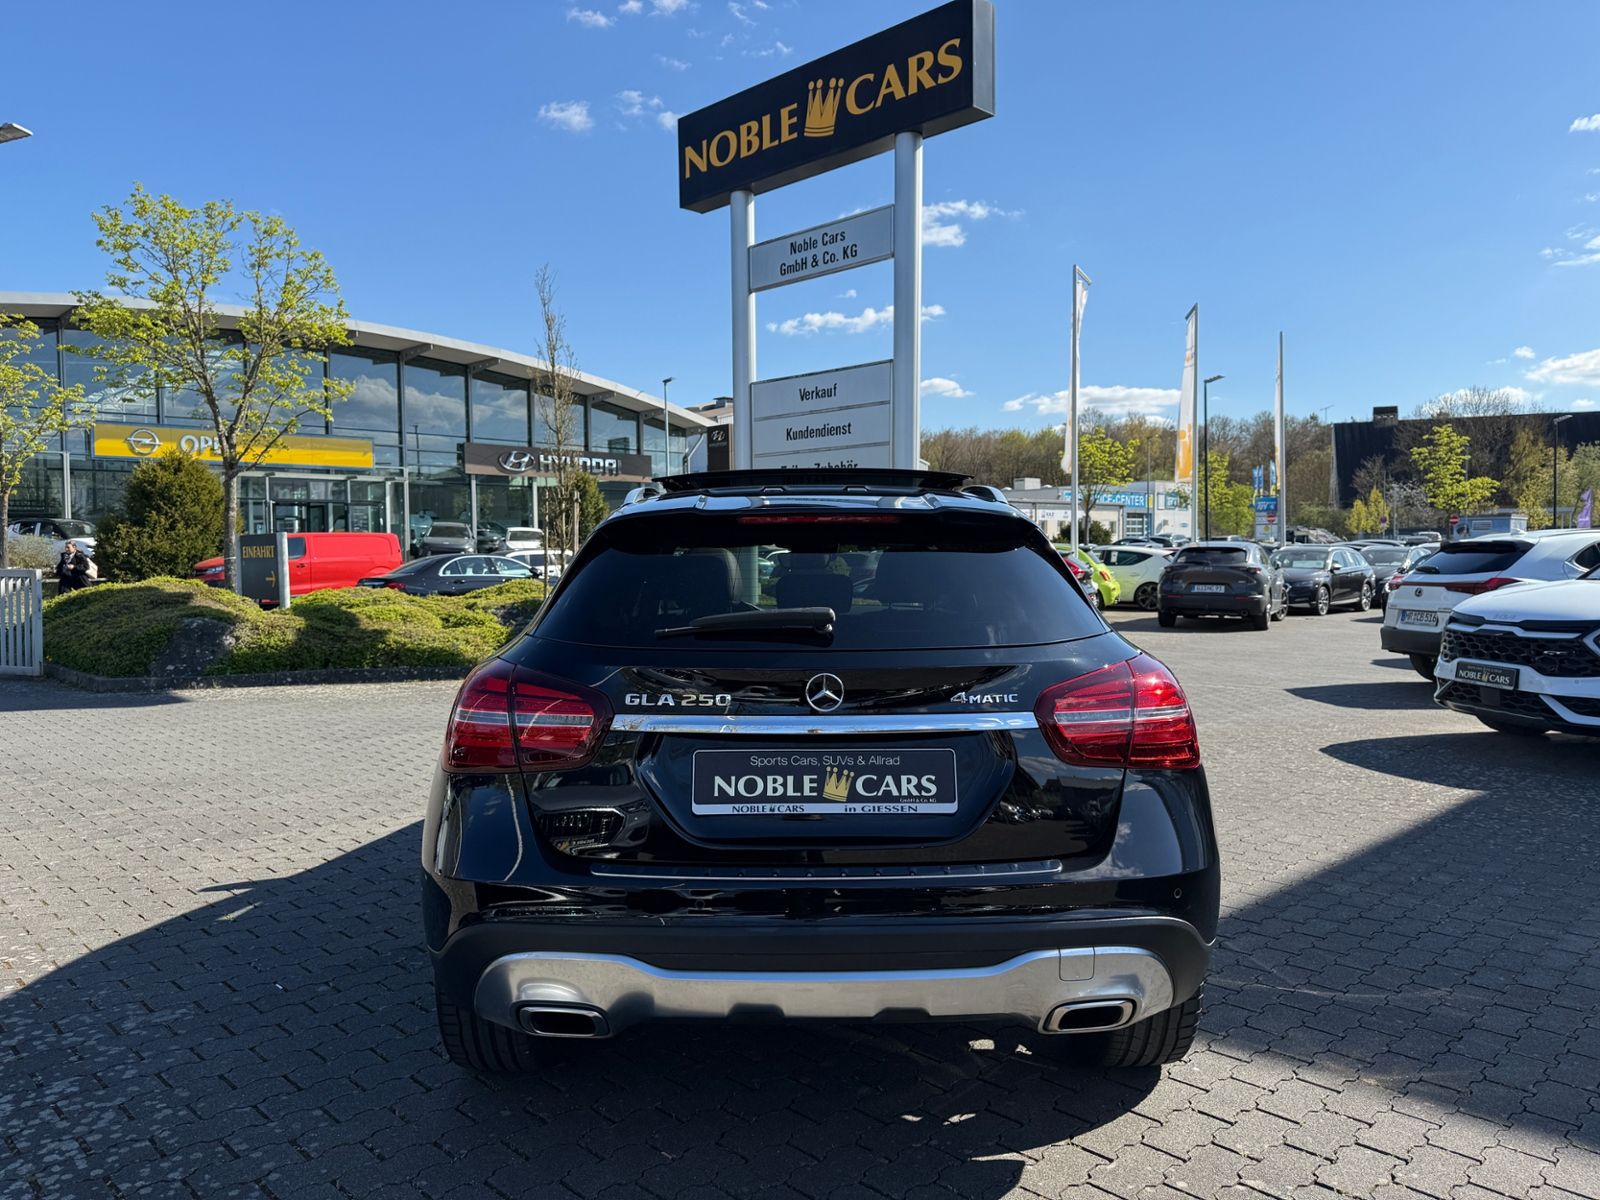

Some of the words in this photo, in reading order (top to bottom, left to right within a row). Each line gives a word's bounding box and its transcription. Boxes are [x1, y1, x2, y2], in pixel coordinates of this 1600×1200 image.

[684, 103, 798, 178] NOBLE
[845, 38, 963, 115] CARS
[790, 236, 818, 255] Noble
[822, 231, 846, 246] Cars
[780, 256, 807, 276] GmbH
[811, 254, 819, 268] &
[823, 251, 839, 265] Co.
[842, 243, 857, 260] KG
[799, 383, 837, 401] Verkauf
[786, 422, 852, 441] Kundendienst
[243, 545, 275, 559] EINFAHRT
[1424, 612, 1437, 623] 516
[1458, 669, 1482, 680] NOBLE
[1489, 674, 1510, 685] CARS
[625, 693, 675, 706] GLA
[681, 693, 731, 707] 250
[950, 691, 1019, 704] 4MATIC
[750, 755, 788, 768] Sports
[791, 755, 820, 767] Cars,
[822, 755, 854, 766] SUVs
[857, 755, 866, 766] &
[868, 755, 900, 766] Allrad
[713, 775, 818, 797] NOBLE
[855, 774, 937, 797] CARS
[731, 804, 769, 813] NOBLE
[777, 804, 804, 813] CARS
[844, 804, 856, 813] in
[860, 804, 918, 813] GIESSEN
